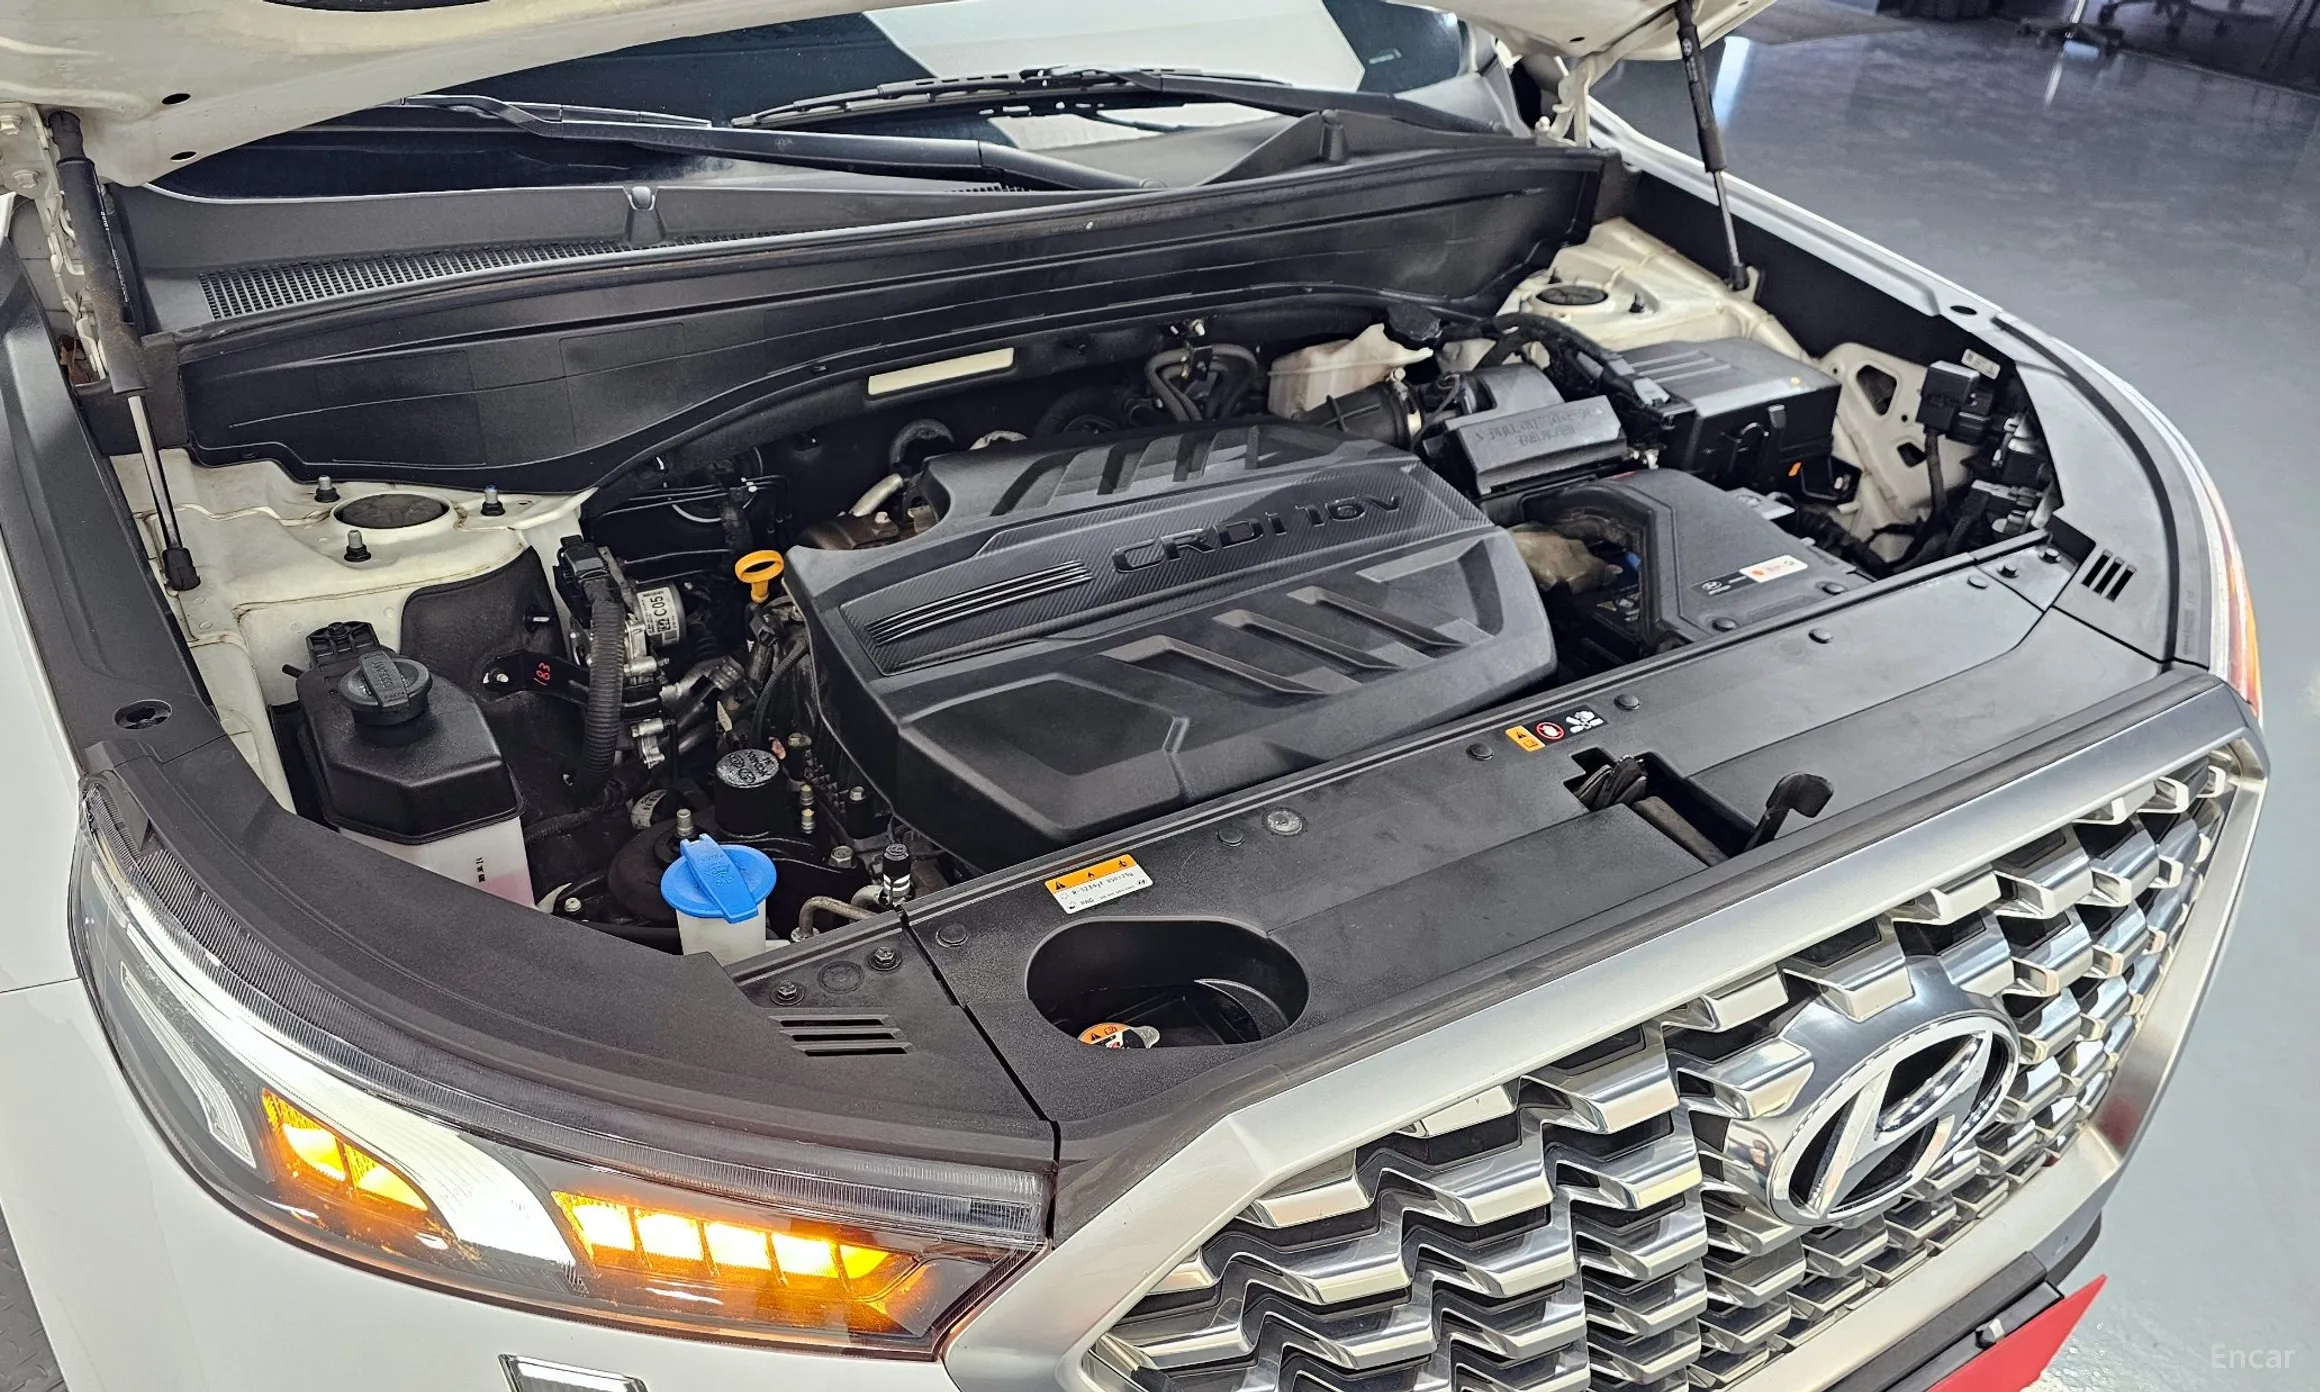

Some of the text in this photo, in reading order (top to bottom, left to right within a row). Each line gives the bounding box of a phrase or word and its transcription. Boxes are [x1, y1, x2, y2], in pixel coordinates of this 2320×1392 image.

[1294, 493, 1404, 528] 16V
[650, 595, 668, 617] C05
[533, 662, 551, 686] 183
